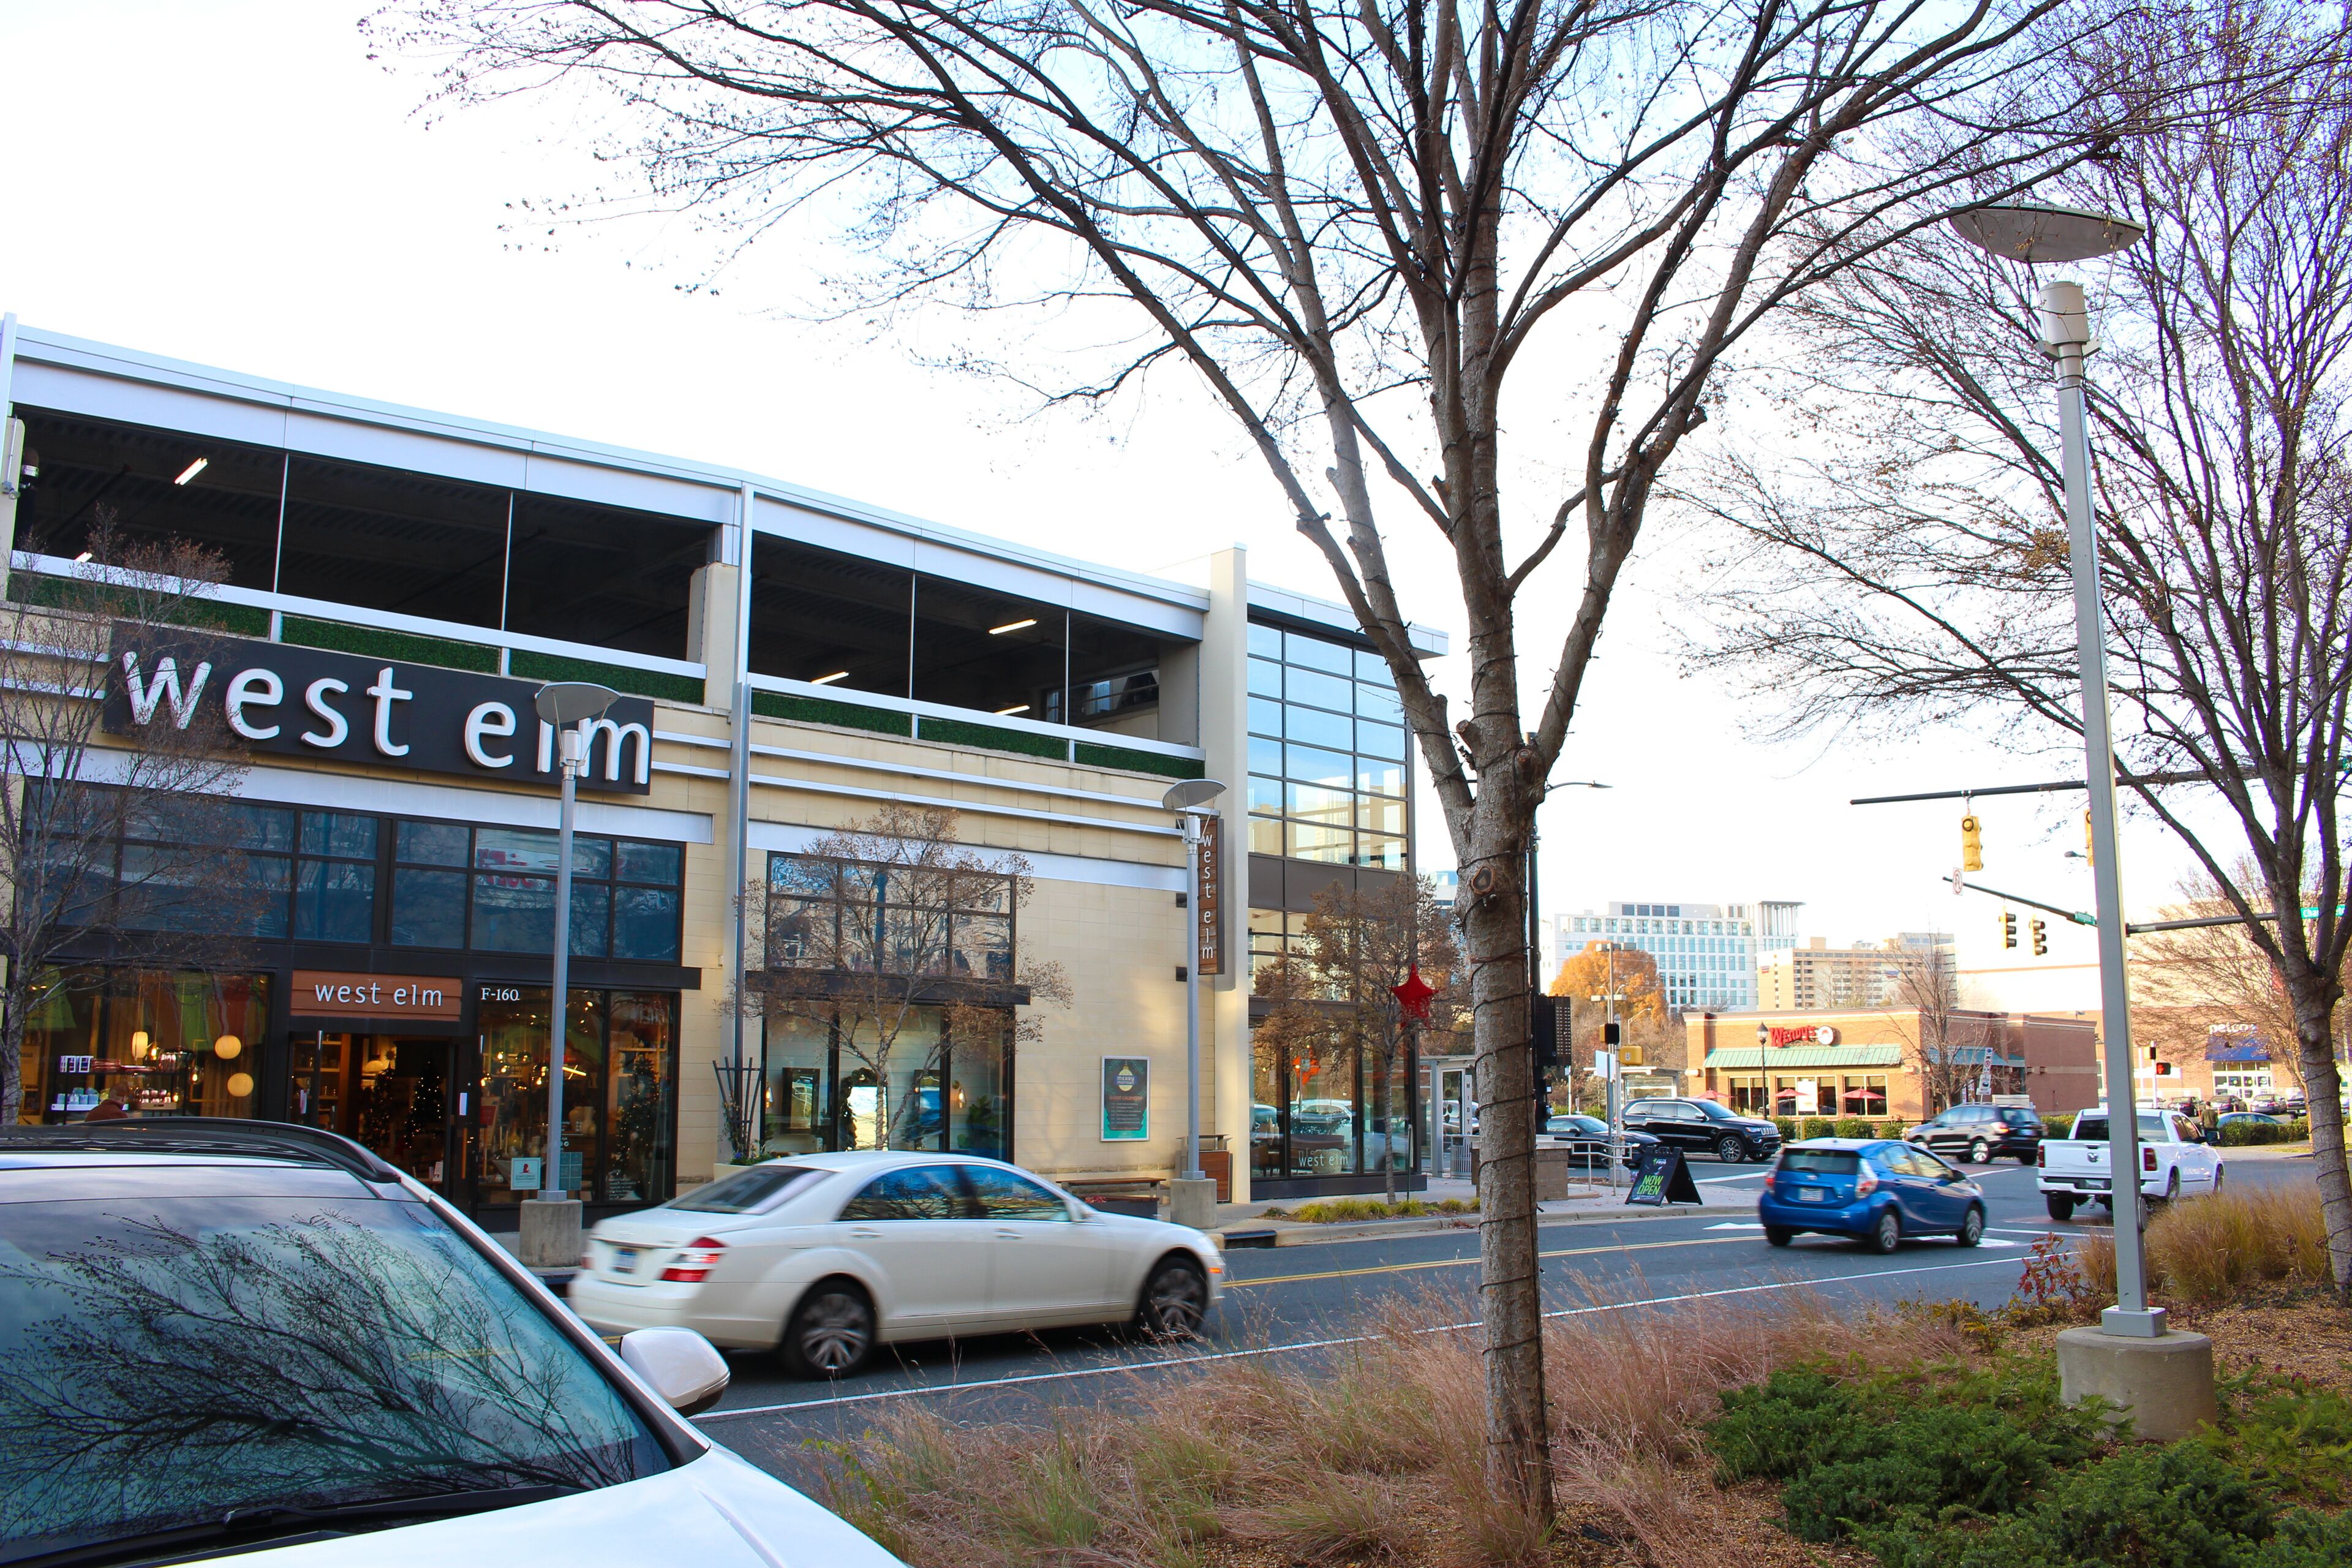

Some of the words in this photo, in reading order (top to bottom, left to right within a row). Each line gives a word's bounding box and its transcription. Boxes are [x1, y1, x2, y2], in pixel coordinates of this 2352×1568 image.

[123, 650, 413, 758] west
[1202, 834, 1213, 899] west
[1202, 910, 1213, 960] elm
[315, 981, 381, 1005] west
[393, 984, 443, 1007] elm
[481, 987, 520, 1001] F-160
[1299, 1154, 1324, 1167] west
[1329, 1154, 1348, 1166] elm
[1642, 1175, 1663, 1185] NOW
[1637, 1186, 1660, 1195] OPEN
